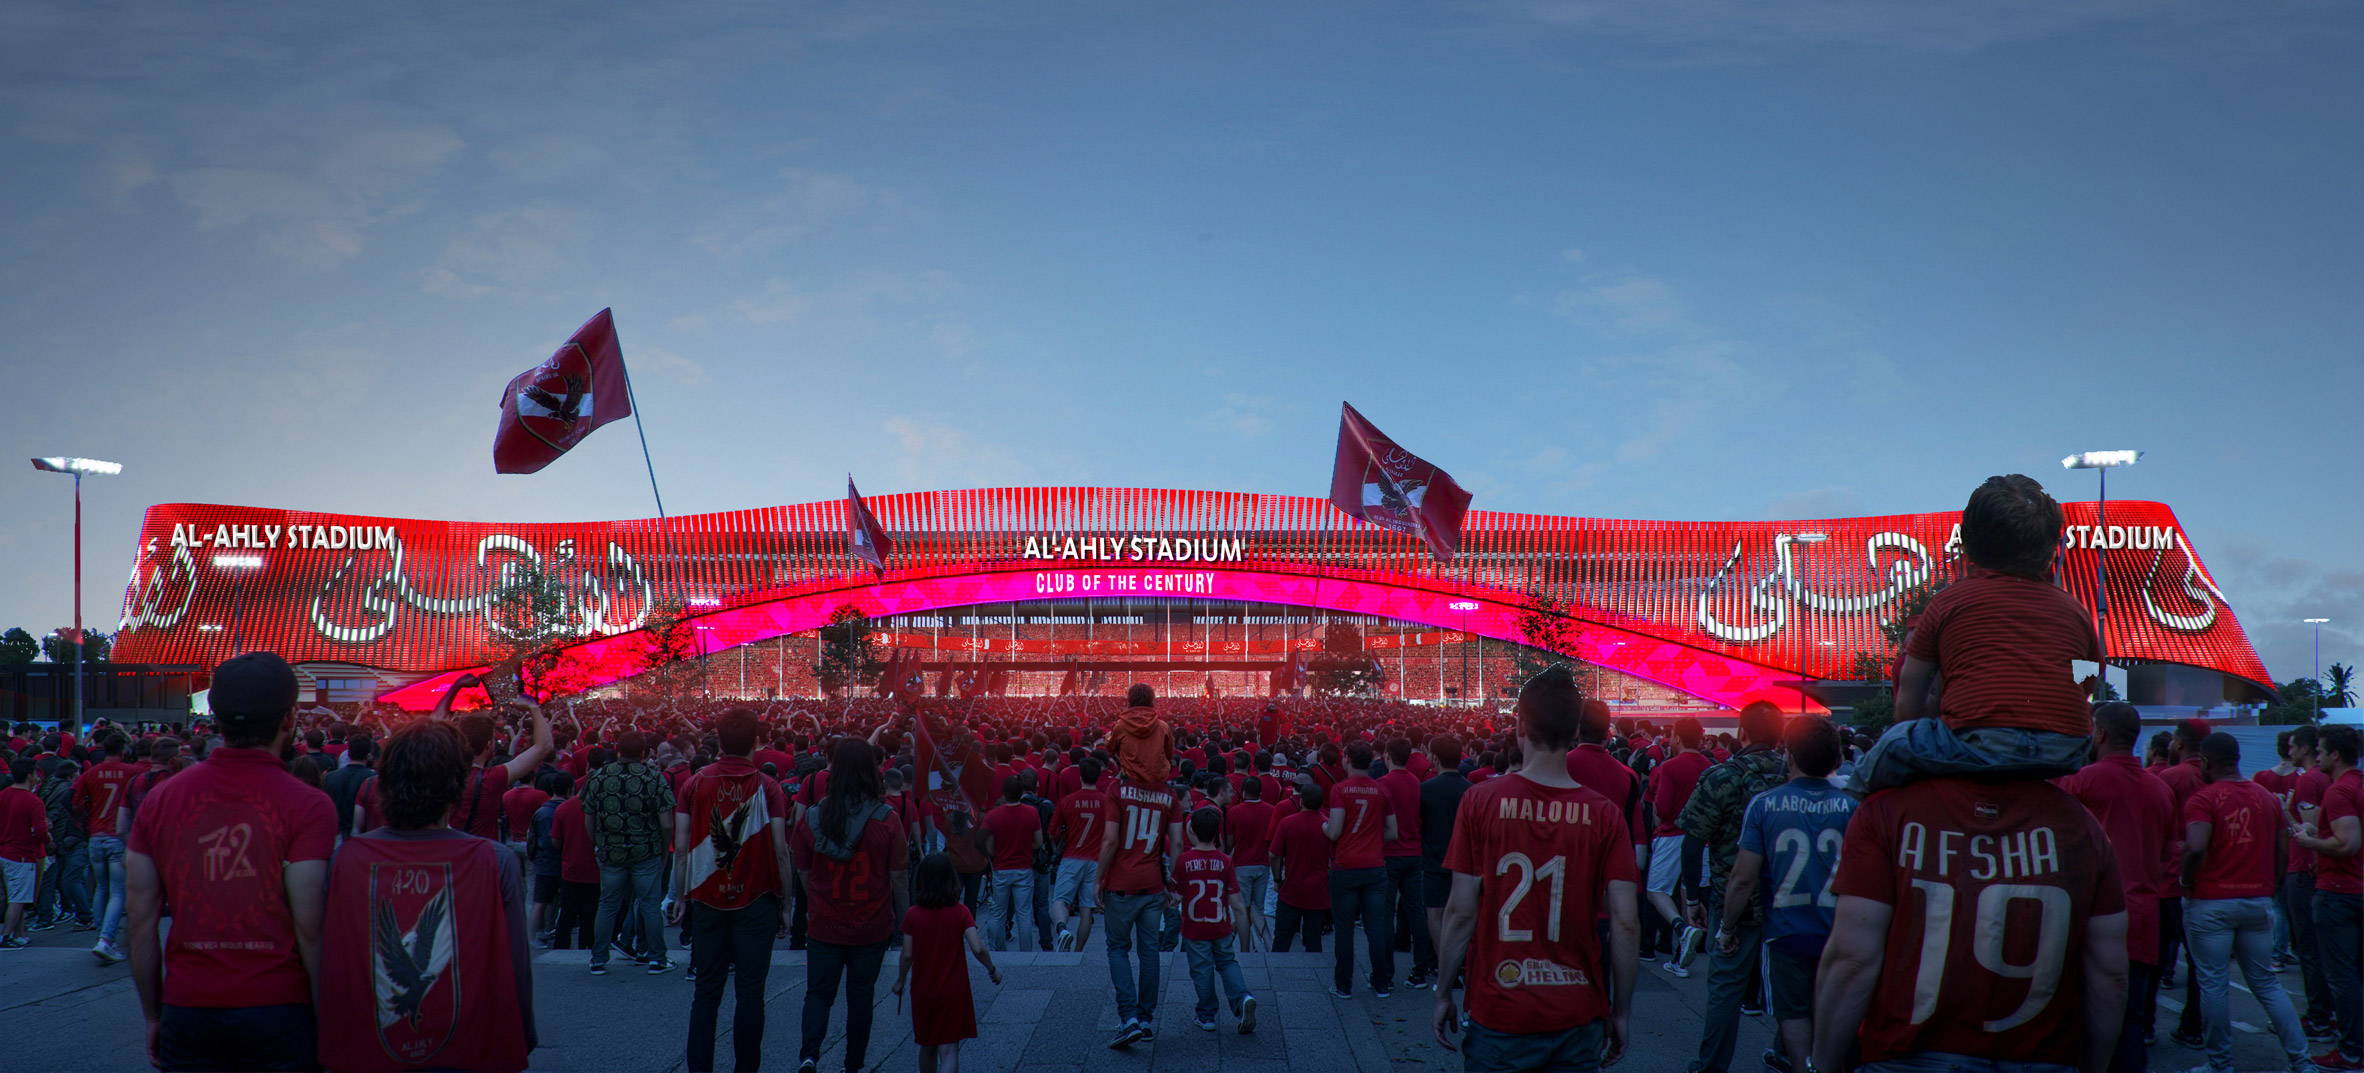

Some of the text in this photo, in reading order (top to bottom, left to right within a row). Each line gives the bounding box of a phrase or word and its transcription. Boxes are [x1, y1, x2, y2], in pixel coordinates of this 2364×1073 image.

[170, 522, 397, 550] AL-AHLY STADIUM
[1023, 535, 1242, 562] AL-AHLY STADIUM
[2065, 524, 2174, 550] STADIUM
[1036, 572, 1215, 594] CLUB OF THE CENTURY
[97, 769, 124, 779] AMIR
[98, 783, 119, 819] 7
[1074, 799, 1101, 809] AMIR
[1351, 799, 1369, 834] 7
[1499, 797, 1592, 826] MALOUL
[1075, 812, 1096, 849] 7
[1124, 804, 1162, 855] 14
[2224, 806, 2255, 851] 72
[197, 822, 258, 882] 72
[1772, 827, 1844, 909] 22
[1898, 821, 2060, 880] AFSHA
[1187, 879, 1225, 924] 23
[1495, 851, 1567, 943] 21
[1908, 878, 2072, 1033] 19
